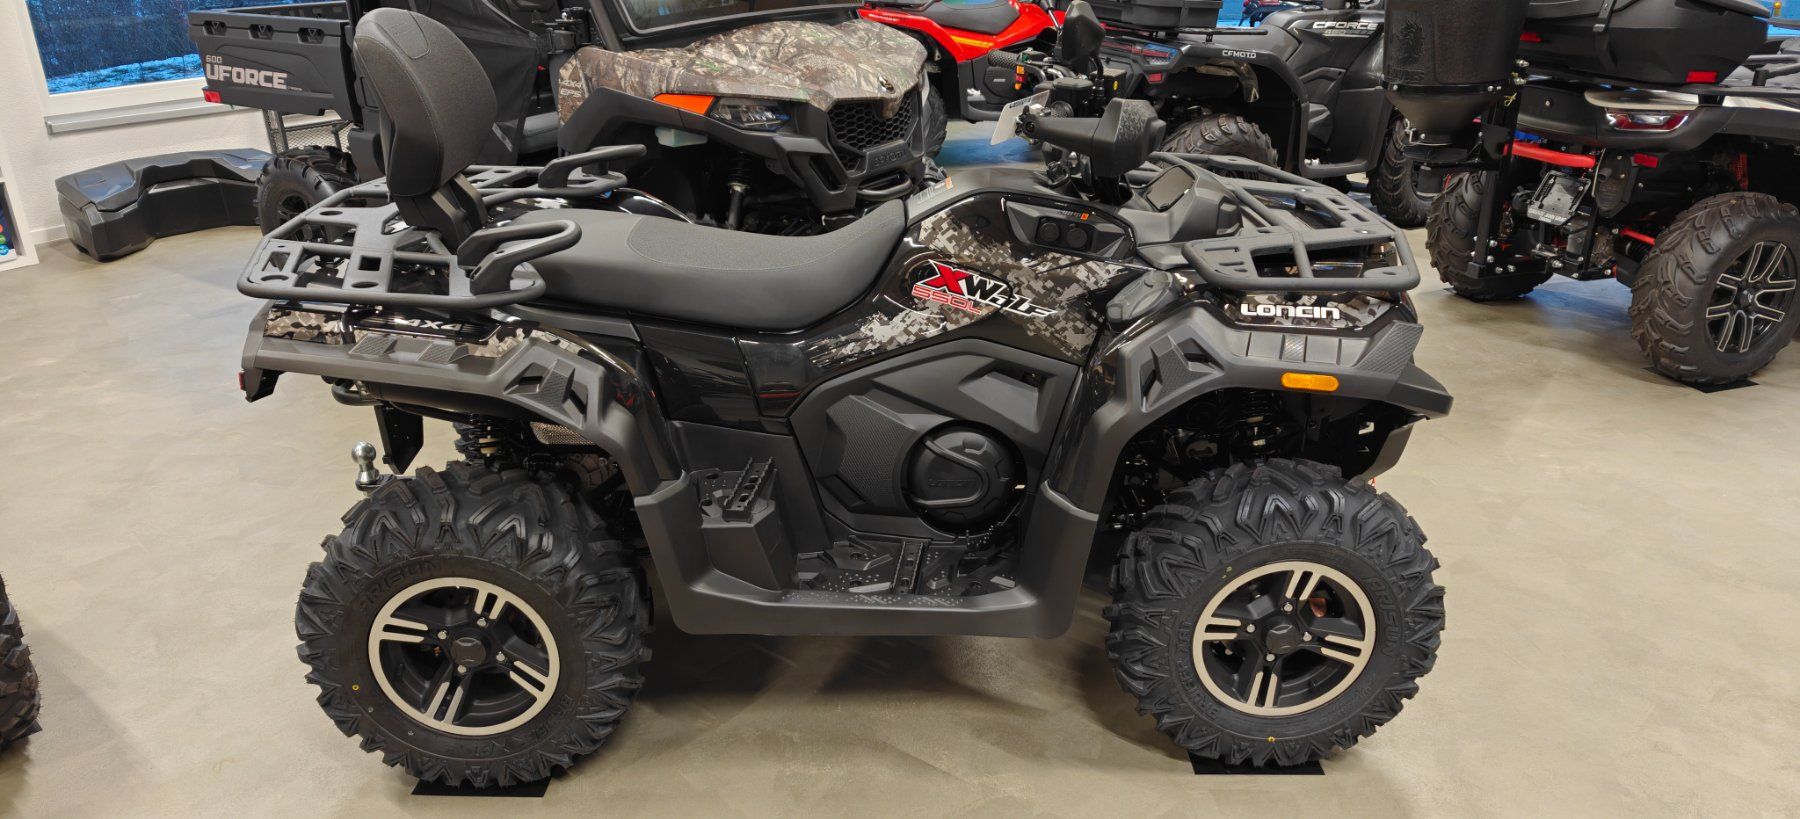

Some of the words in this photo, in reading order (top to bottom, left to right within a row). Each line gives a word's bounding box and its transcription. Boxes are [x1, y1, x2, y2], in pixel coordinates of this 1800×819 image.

[1312, 21, 1379, 30] CFORCE
[206, 54, 223, 63] 600
[1222, 50, 1256, 59] CFMOTO
[206, 63, 288, 90] UFORCE
[1240, 303, 1341, 320] LONCIN
